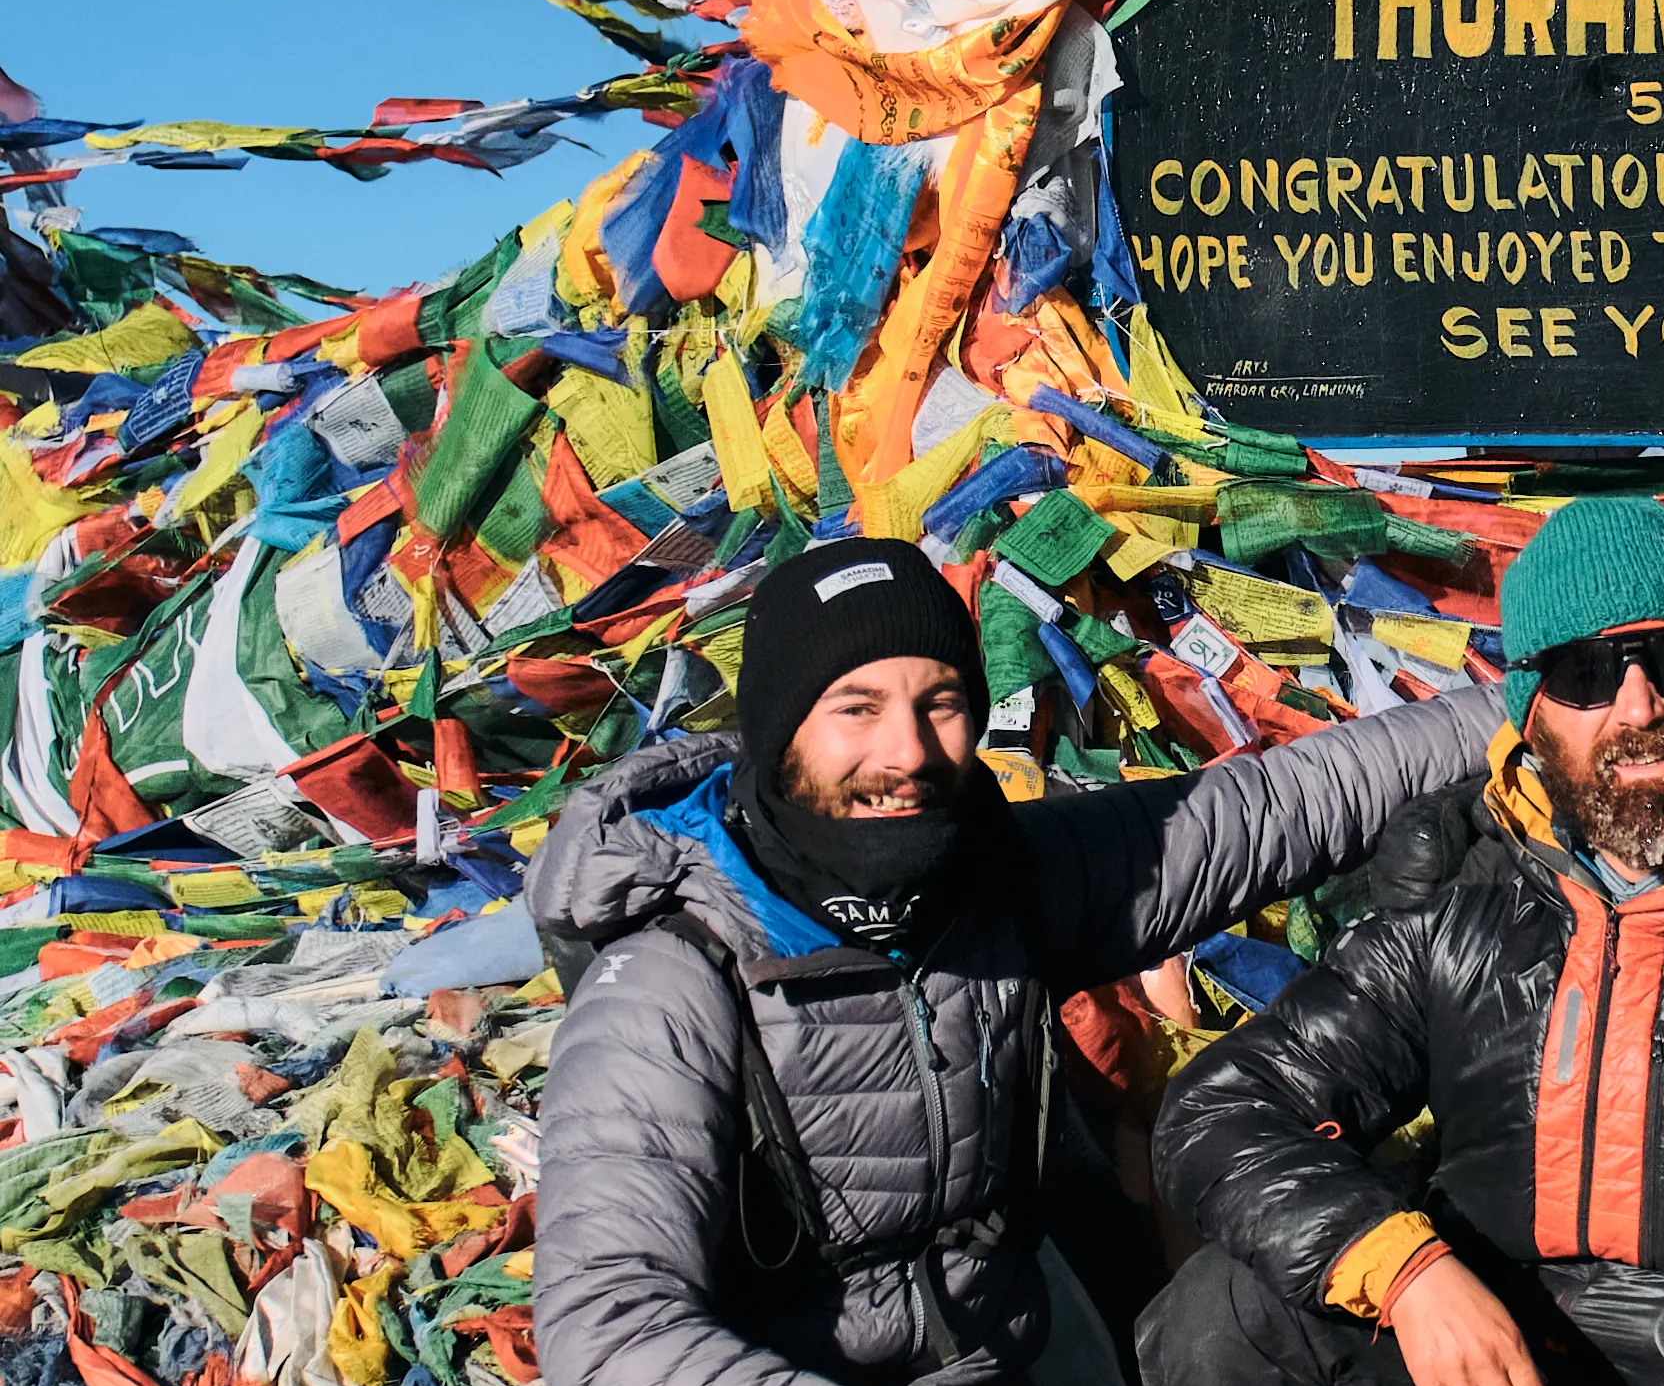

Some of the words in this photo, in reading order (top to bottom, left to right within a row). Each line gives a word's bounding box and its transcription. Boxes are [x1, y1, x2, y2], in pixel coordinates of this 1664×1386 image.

[1131, 234, 1253, 293] HOPE
[1273, 232, 1374, 287] YOU
[1392, 230, 1631, 285] ENJOYED
[1441, 306, 1577, 359] SEE
